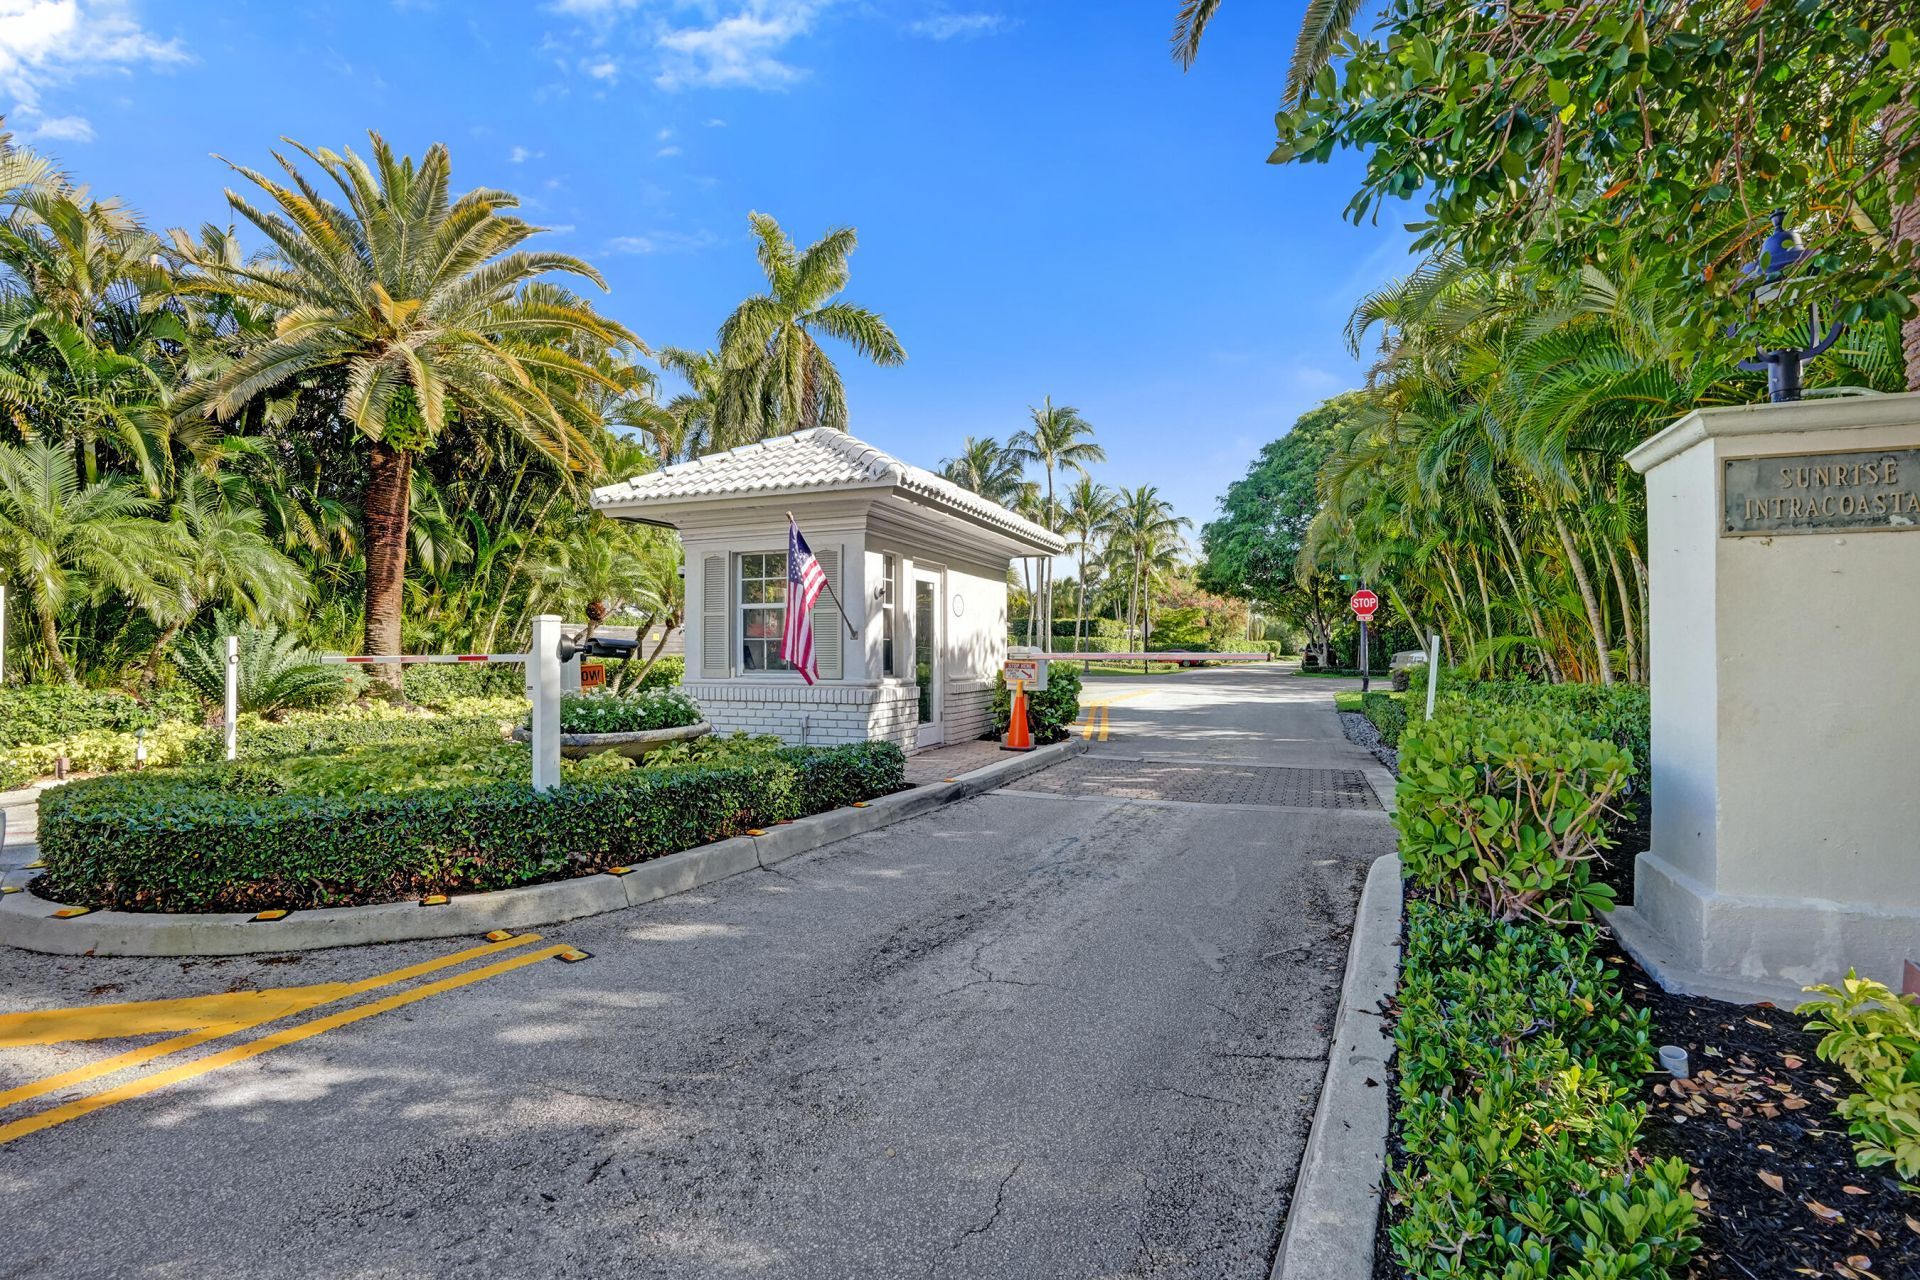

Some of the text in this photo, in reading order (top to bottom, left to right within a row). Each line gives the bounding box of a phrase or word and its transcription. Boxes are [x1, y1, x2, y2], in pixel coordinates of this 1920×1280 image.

[1780, 462, 1898, 489] SUNRISE
[1744, 492, 1920, 520] INTRACOASTA
[1353, 598, 1376, 608] STOP
